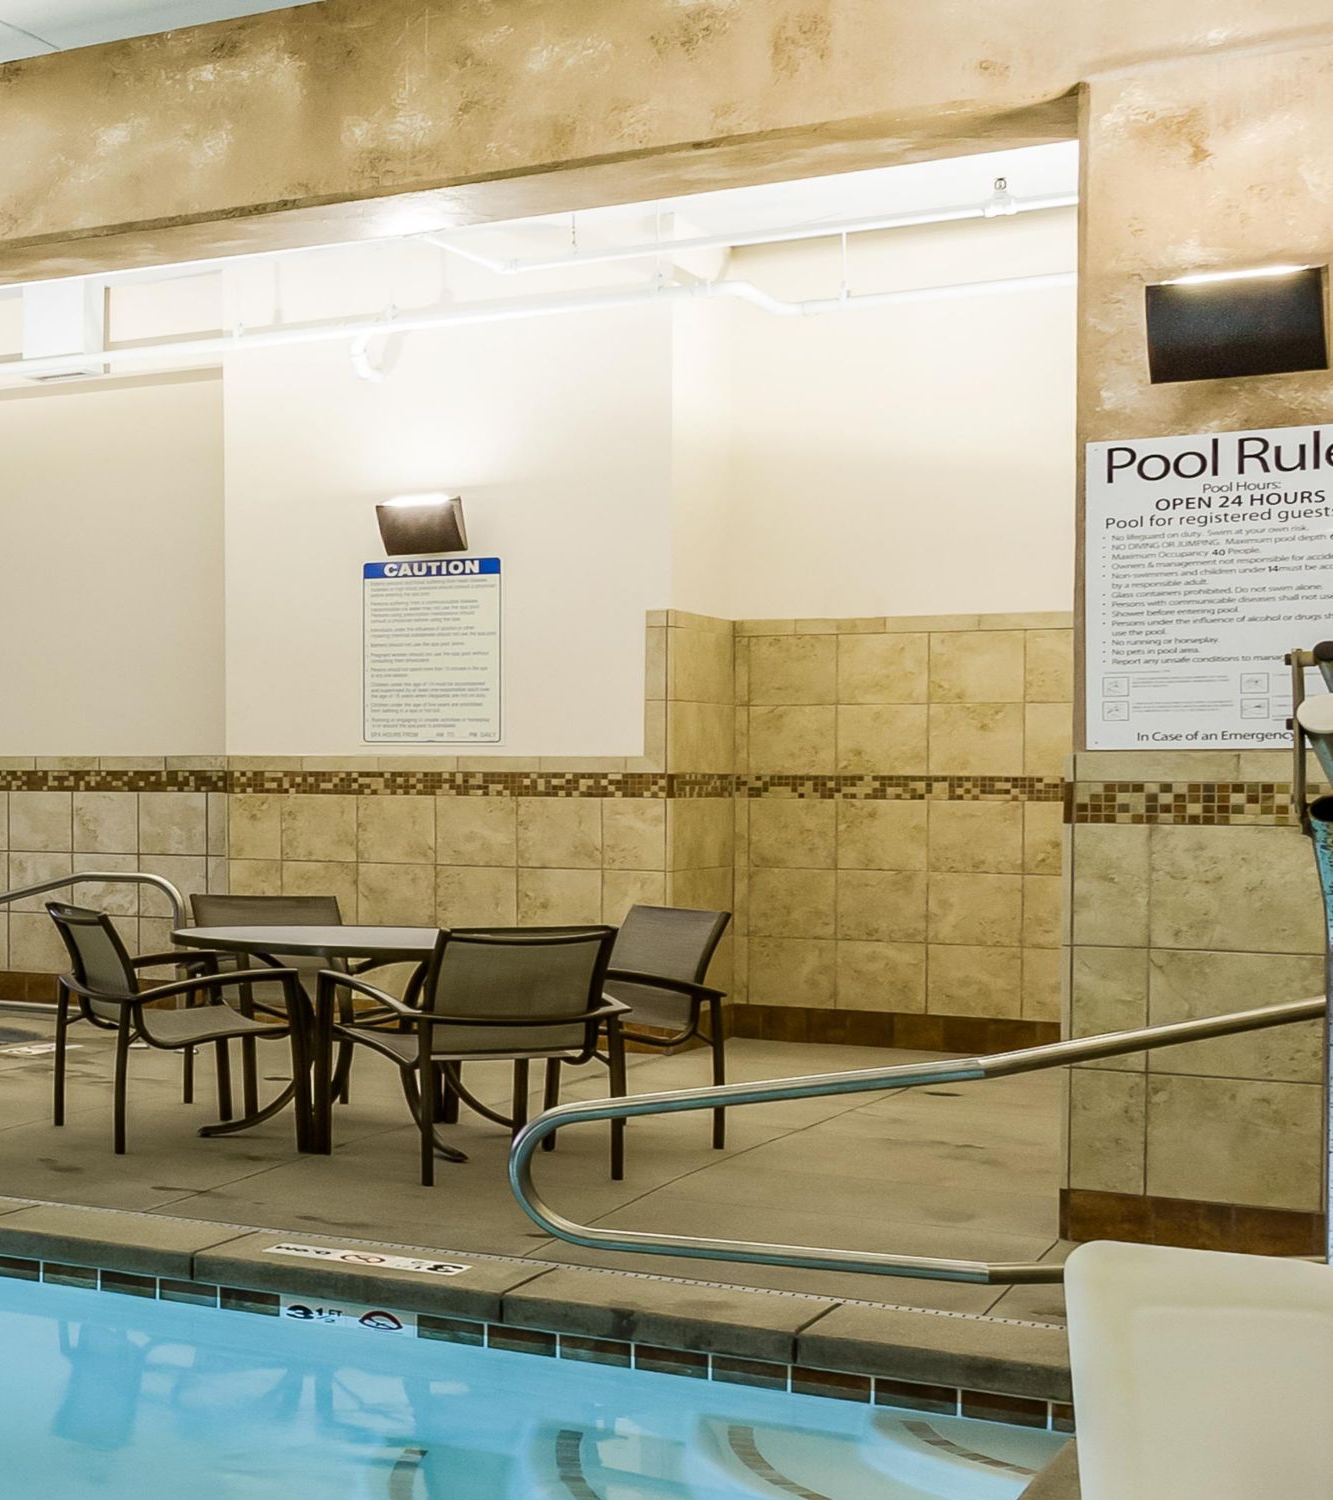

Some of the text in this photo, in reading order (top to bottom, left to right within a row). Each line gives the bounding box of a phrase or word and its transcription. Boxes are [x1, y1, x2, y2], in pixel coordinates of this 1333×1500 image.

[1107, 438, 1219, 484] Pool
[1202, 481, 1282, 493] Pool Hours:
[1155, 490, 1326, 511] OPEN 24 HOURS
[1105, 516, 1144, 530] Pool
[1150, 513, 1173, 527] for
[1179, 508, 1272, 528] registered
[1111, 543, 1127, 551] NO
[1274, 534, 1297, 544] pool
[1211, 548, 1226, 556] 40
[384, 560, 480, 577] CAUTION
[1180, 569, 1198, 577] and
[1304, 563, 1318, 571] be
[1319, 563, 1333, 571] acc
[1234, 586, 1249, 594] Do
[1301, 593, 1318, 601] not
[1111, 639, 1125, 647] No
[1157, 647, 1178, 657] pool
[1137, 732, 1150, 742] In
[1152, 731, 1183, 742] Case
[1185, 730, 1200, 742] of
[1201, 731, 1218, 742] an
[286, 1304, 315, 1321] 3
